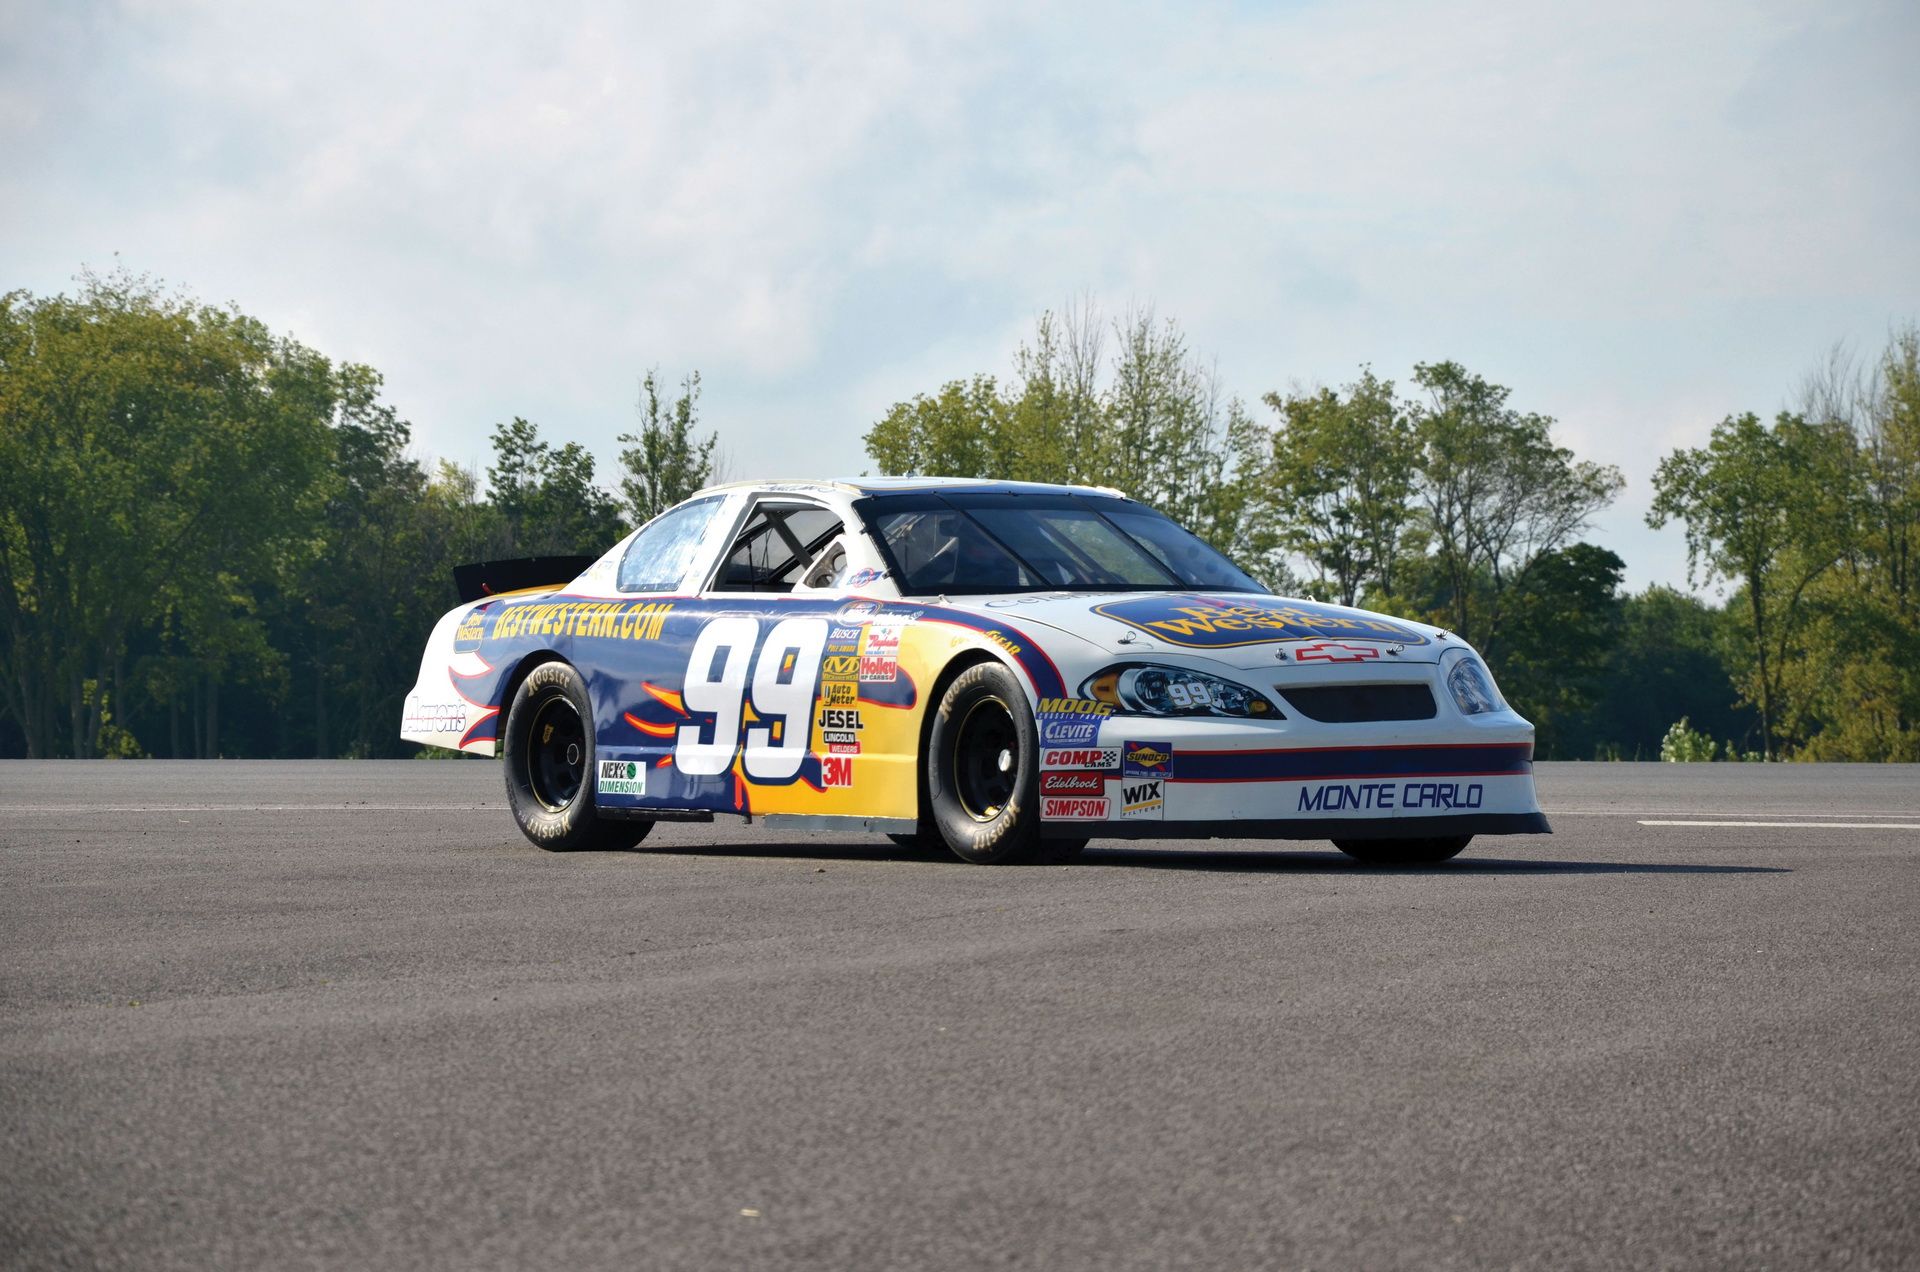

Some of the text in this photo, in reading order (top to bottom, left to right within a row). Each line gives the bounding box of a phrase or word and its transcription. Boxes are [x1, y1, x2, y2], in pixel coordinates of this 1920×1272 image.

[492, 602, 675, 641] BESTWESTERN.COM
[1169, 606, 1318, 619] Best
[829, 627, 860, 640] BUSCH
[1145, 615, 1404, 635] Western
[861, 657, 896, 680] Holley
[527, 668, 571, 697] Hoosier
[832, 684, 852, 695] Auto
[675, 615, 829, 779] 99
[830, 695, 855, 705] Meter
[1167, 681, 1212, 706] 99
[402, 695, 467, 733] Aaron's
[1035, 697, 1114, 716] MOOG
[818, 709, 864, 729] JESEL
[824, 732, 855, 743] LINCOLN
[1044, 721, 1095, 739] CLEVITE
[831, 745, 858, 754] WELDERS
[1045, 750, 1103, 766] COMP
[1127, 752, 1168, 762] SUNOCO
[823, 757, 852, 786] 3M
[599, 780, 643, 794] DIMENSION
[1045, 775, 1098, 789] Edelbrock
[1123, 781, 1161, 805] WIX
[1297, 783, 1483, 812] MONTE CARLO
[1045, 799, 1106, 817] SIMPSON
[1122, 804, 1162, 817] FILTERS
[526, 811, 572, 839] Hoosier
